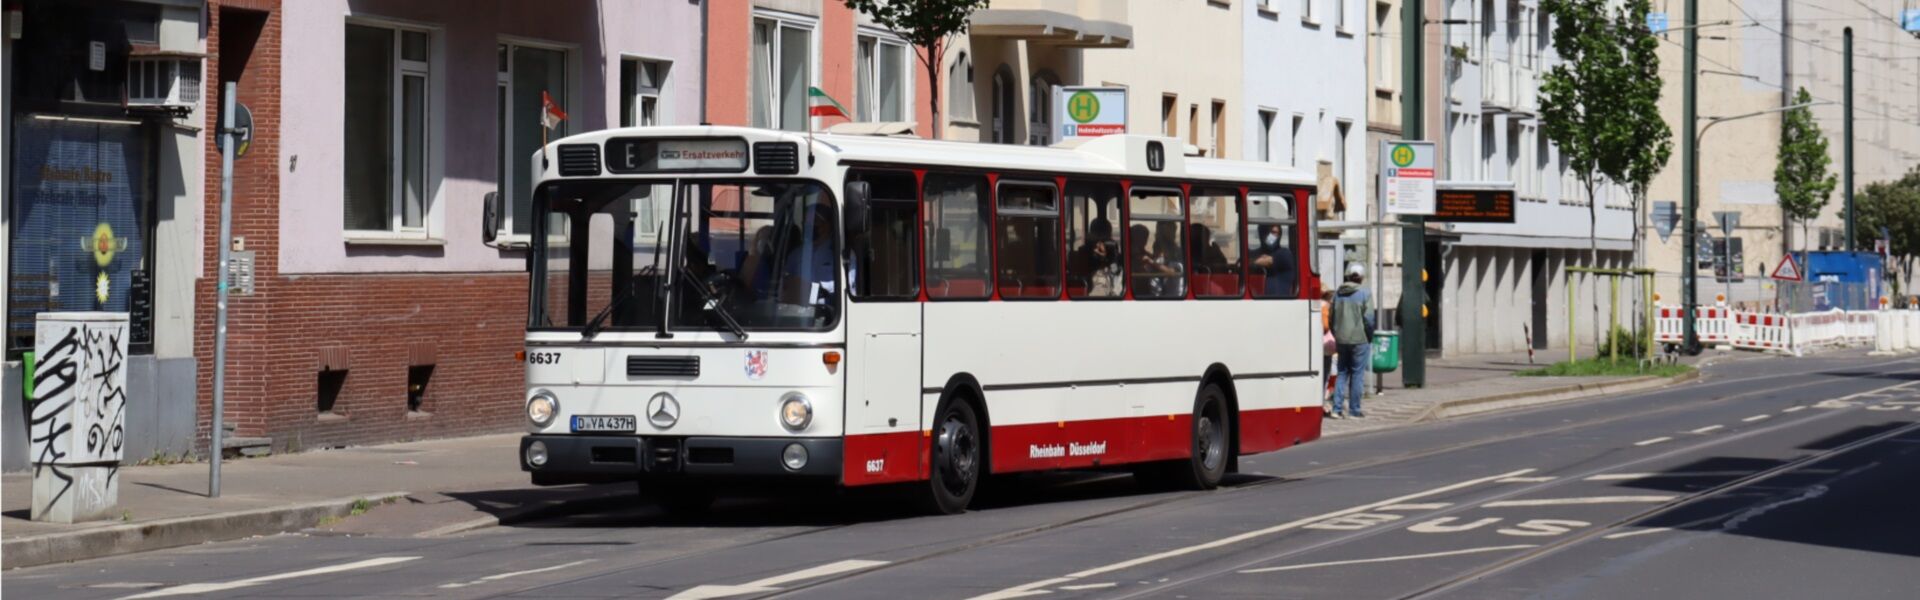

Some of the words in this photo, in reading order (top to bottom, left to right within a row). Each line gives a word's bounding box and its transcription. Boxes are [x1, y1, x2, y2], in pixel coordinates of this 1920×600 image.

[625, 143, 635, 168] E
[682, 150, 745, 160] Ersatzverkehr
[530, 353, 561, 364] 6637
[592, 418, 605, 430] YA
[607, 417, 634, 429] 437H
[1029, 444, 1066, 459] Rheinbahn
[1069, 440, 1107, 455] Düsseldorf
[866, 459, 884, 472] 6637
[1302, 513, 1592, 536] BUS
